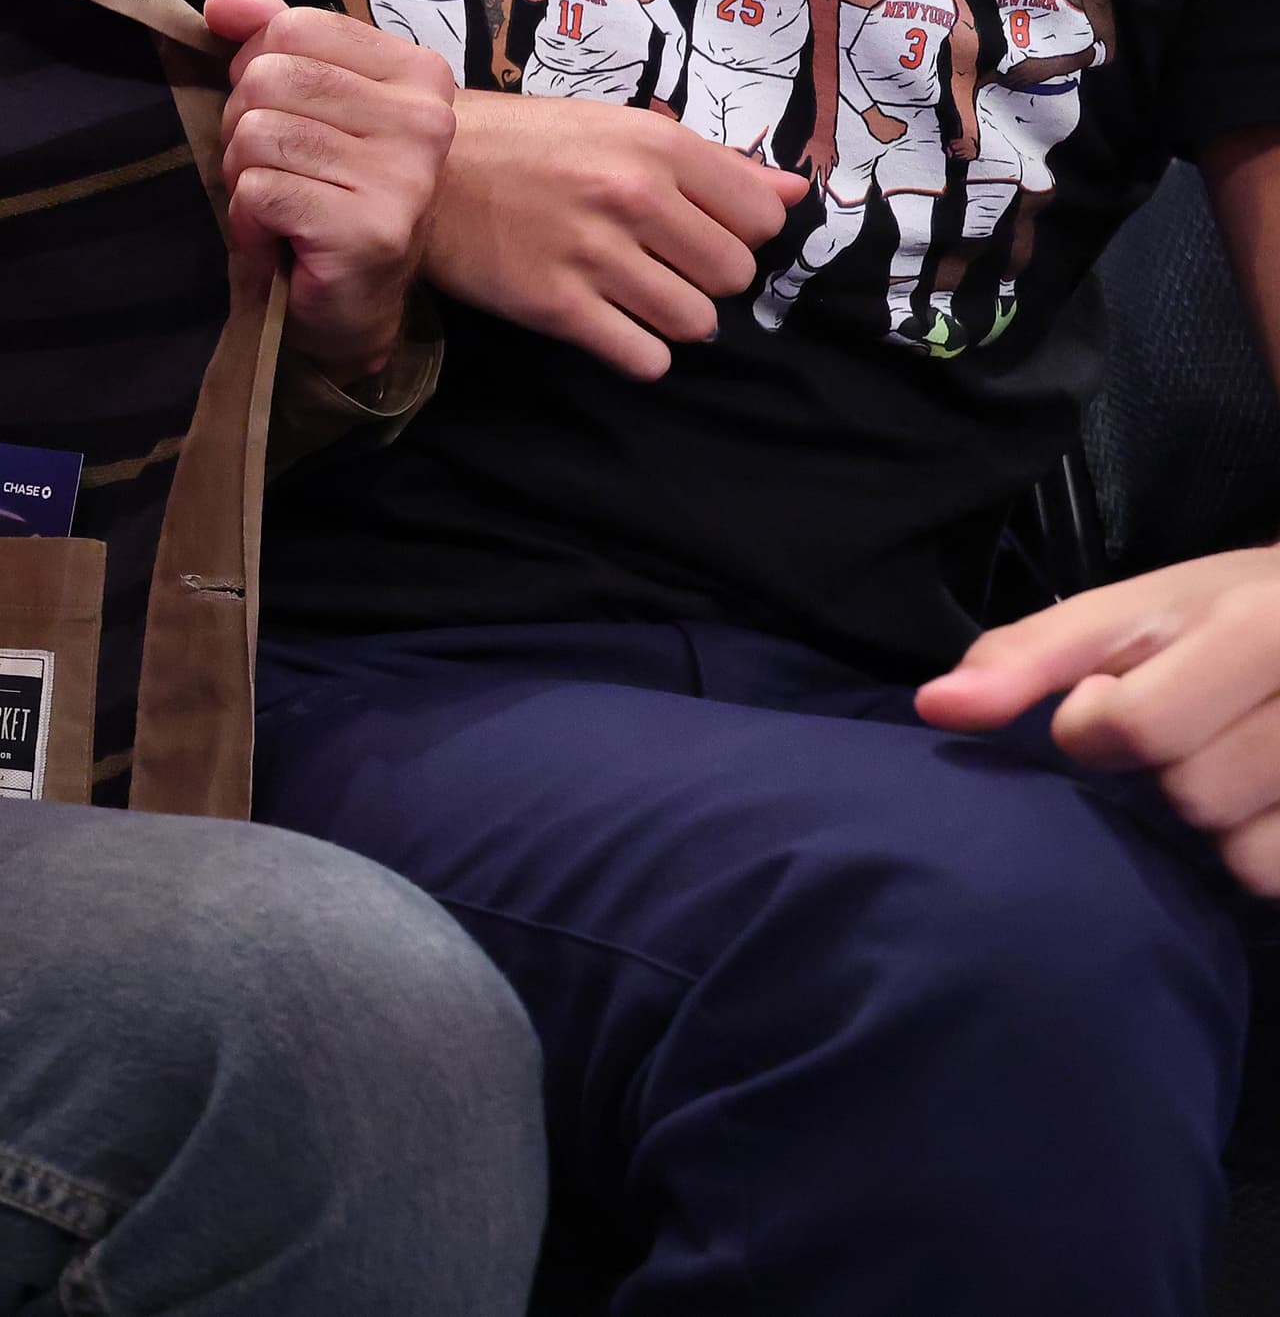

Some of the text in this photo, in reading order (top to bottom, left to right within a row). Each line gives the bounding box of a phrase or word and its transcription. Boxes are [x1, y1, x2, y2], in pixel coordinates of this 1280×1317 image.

[557, 0, 584, 40] 11
[882, 1, 954, 30] NEW YORK
[1010, 9, 1031, 48] 8
[899, 28, 928, 70] 3
[3, 482, 41, 497] CHASE
